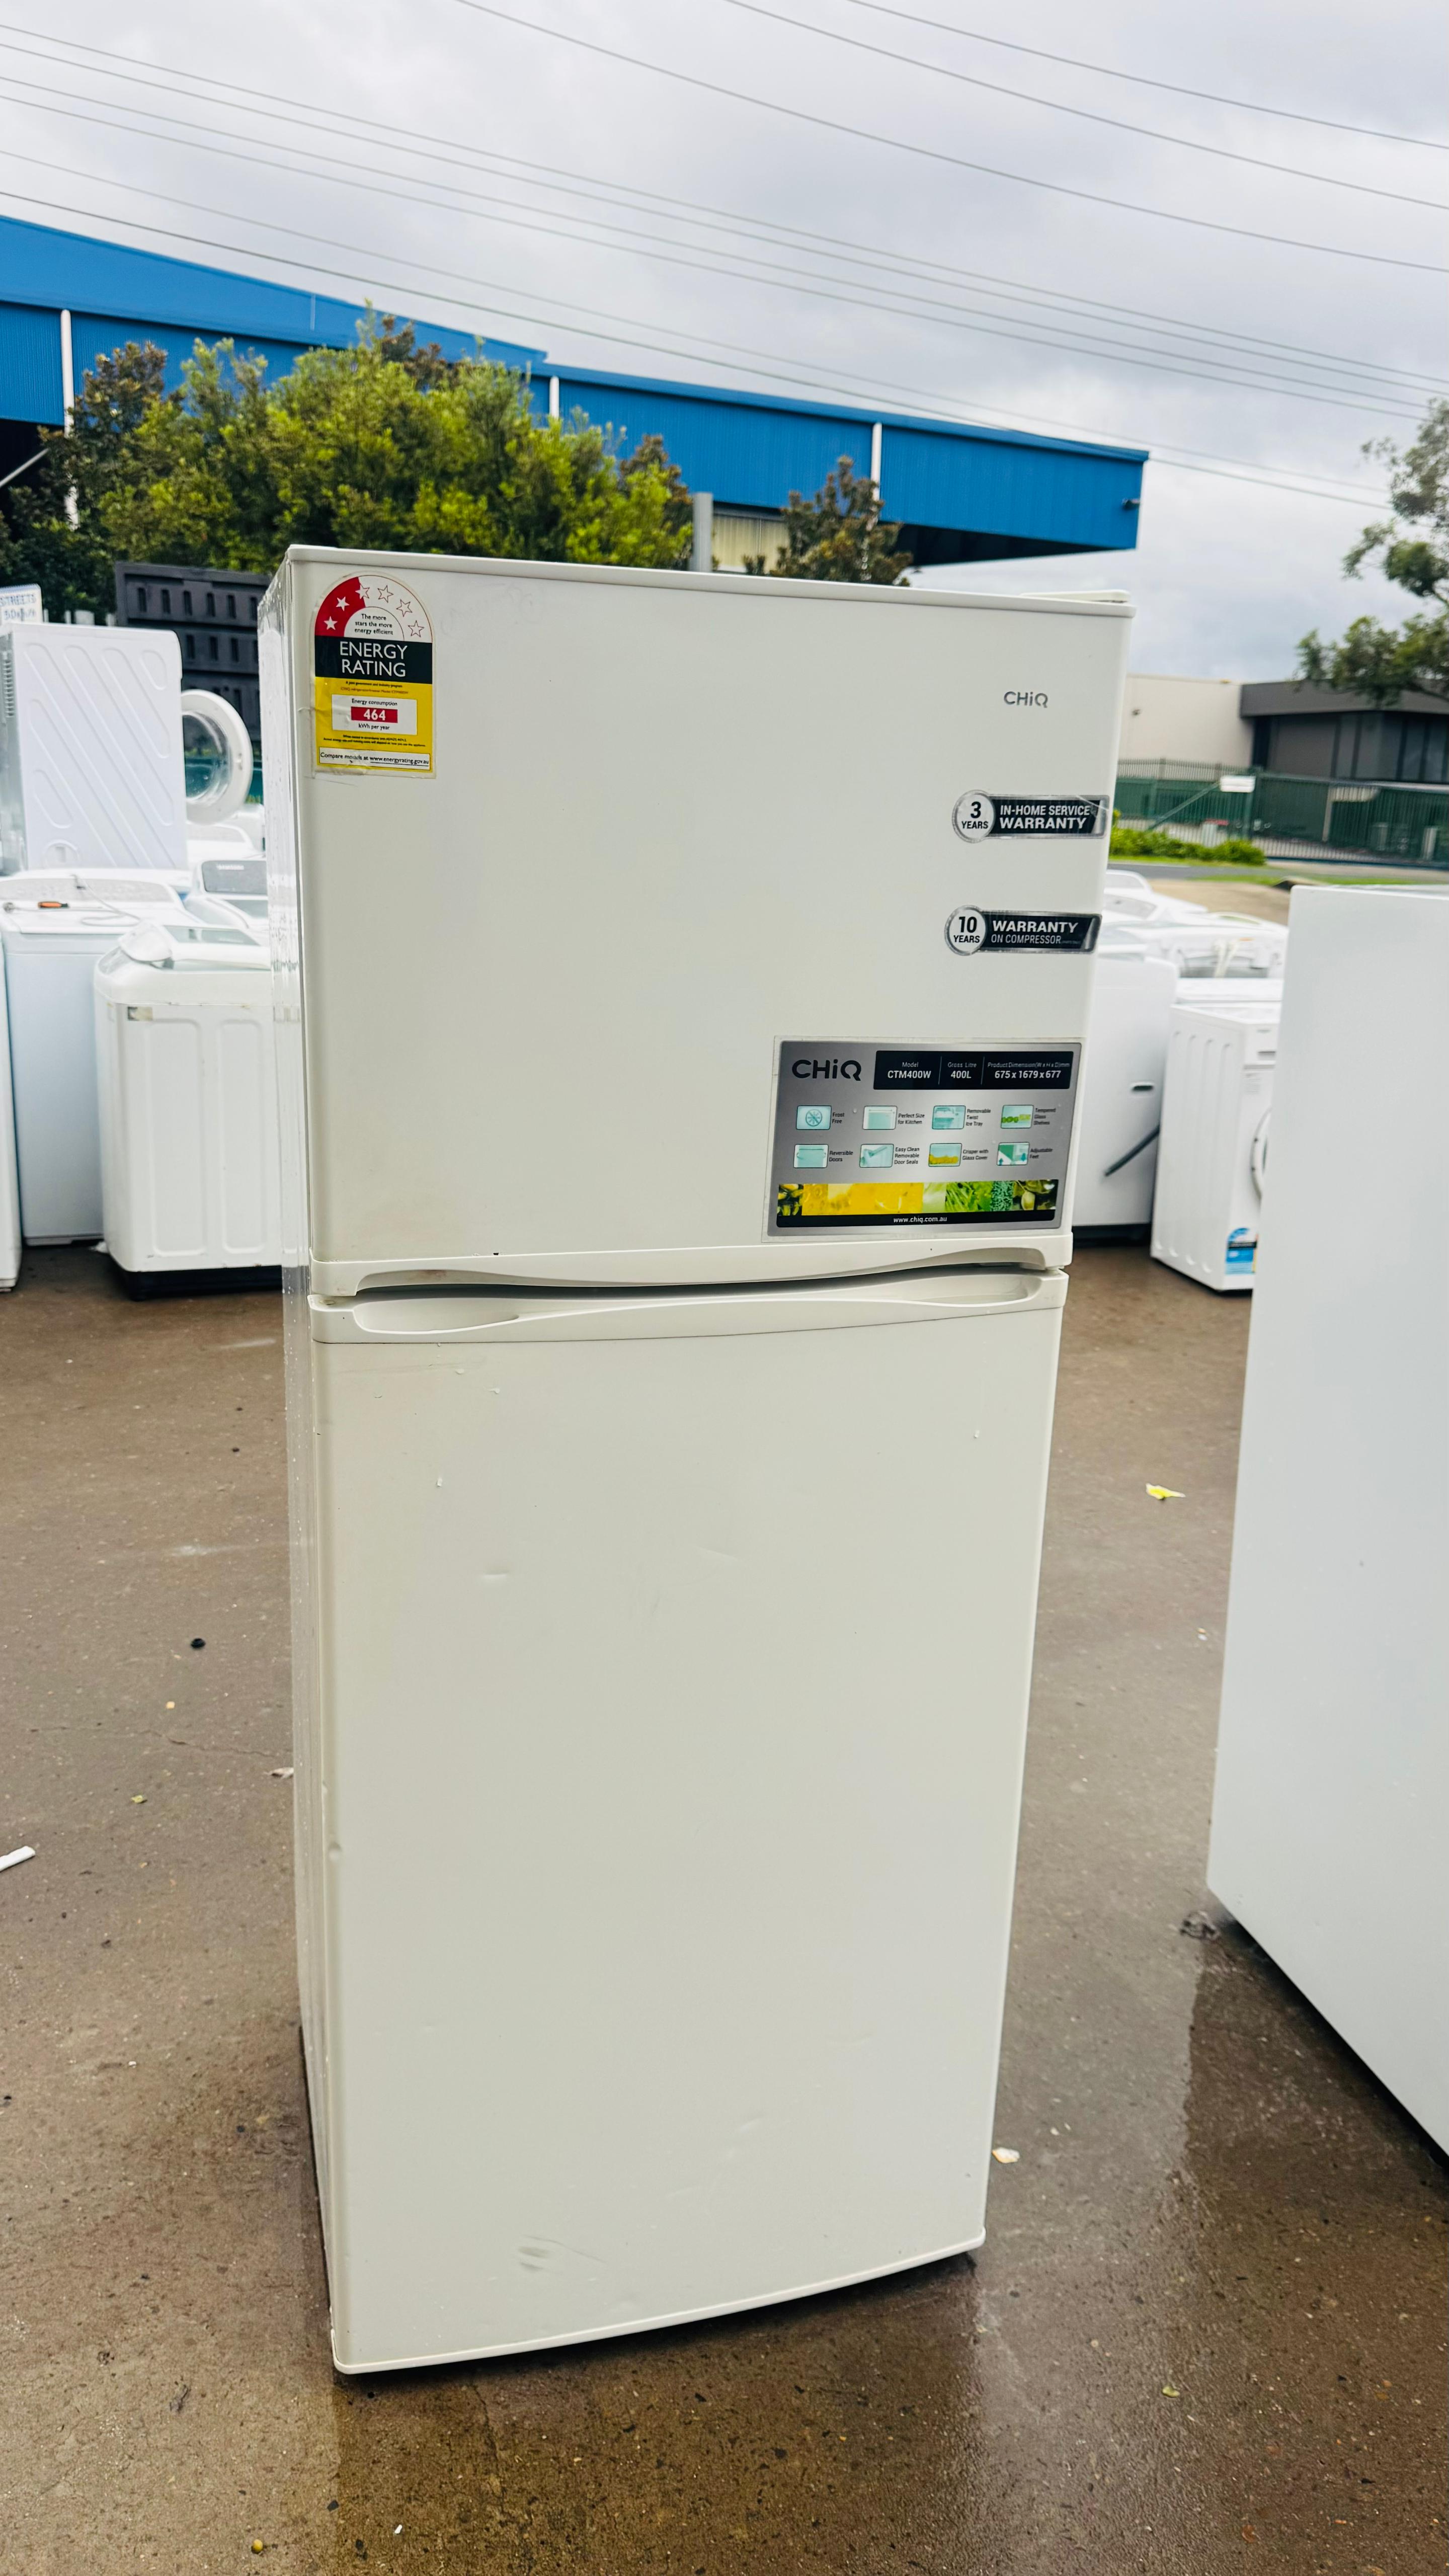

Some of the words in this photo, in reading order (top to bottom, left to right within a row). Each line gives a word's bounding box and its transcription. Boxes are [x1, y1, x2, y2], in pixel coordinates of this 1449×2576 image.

[340, 641, 408, 660] ENERGY
[342, 659, 406, 677] RATING
[1004, 691, 1048, 708] CHiQ
[363, 708, 386, 720] 464
[971, 801, 981, 819] 3
[1000, 805, 1046, 815] IN-HOME
[1049, 805, 1090, 816] SERVICE
[961, 821, 989, 829] YEARS
[999, 818, 1087, 829] WARRANTY
[958, 916, 977, 933] 10
[993, 920, 1078, 933] WARRANTY
[953, 935, 980, 943] YEARS
[991, 934, 1003, 943] ON
[1006, 934, 1061, 944] COMPRESSOR
[792, 1059, 861, 1081] CHiQ
[888, 1070, 931, 1079] CTM400W
[951, 1070, 972, 1079] 400L
[995, 1071, 1010, 1079] 675
[1019, 1070, 1038, 1079] 1679
[1045, 1070, 1061, 1078] 677
